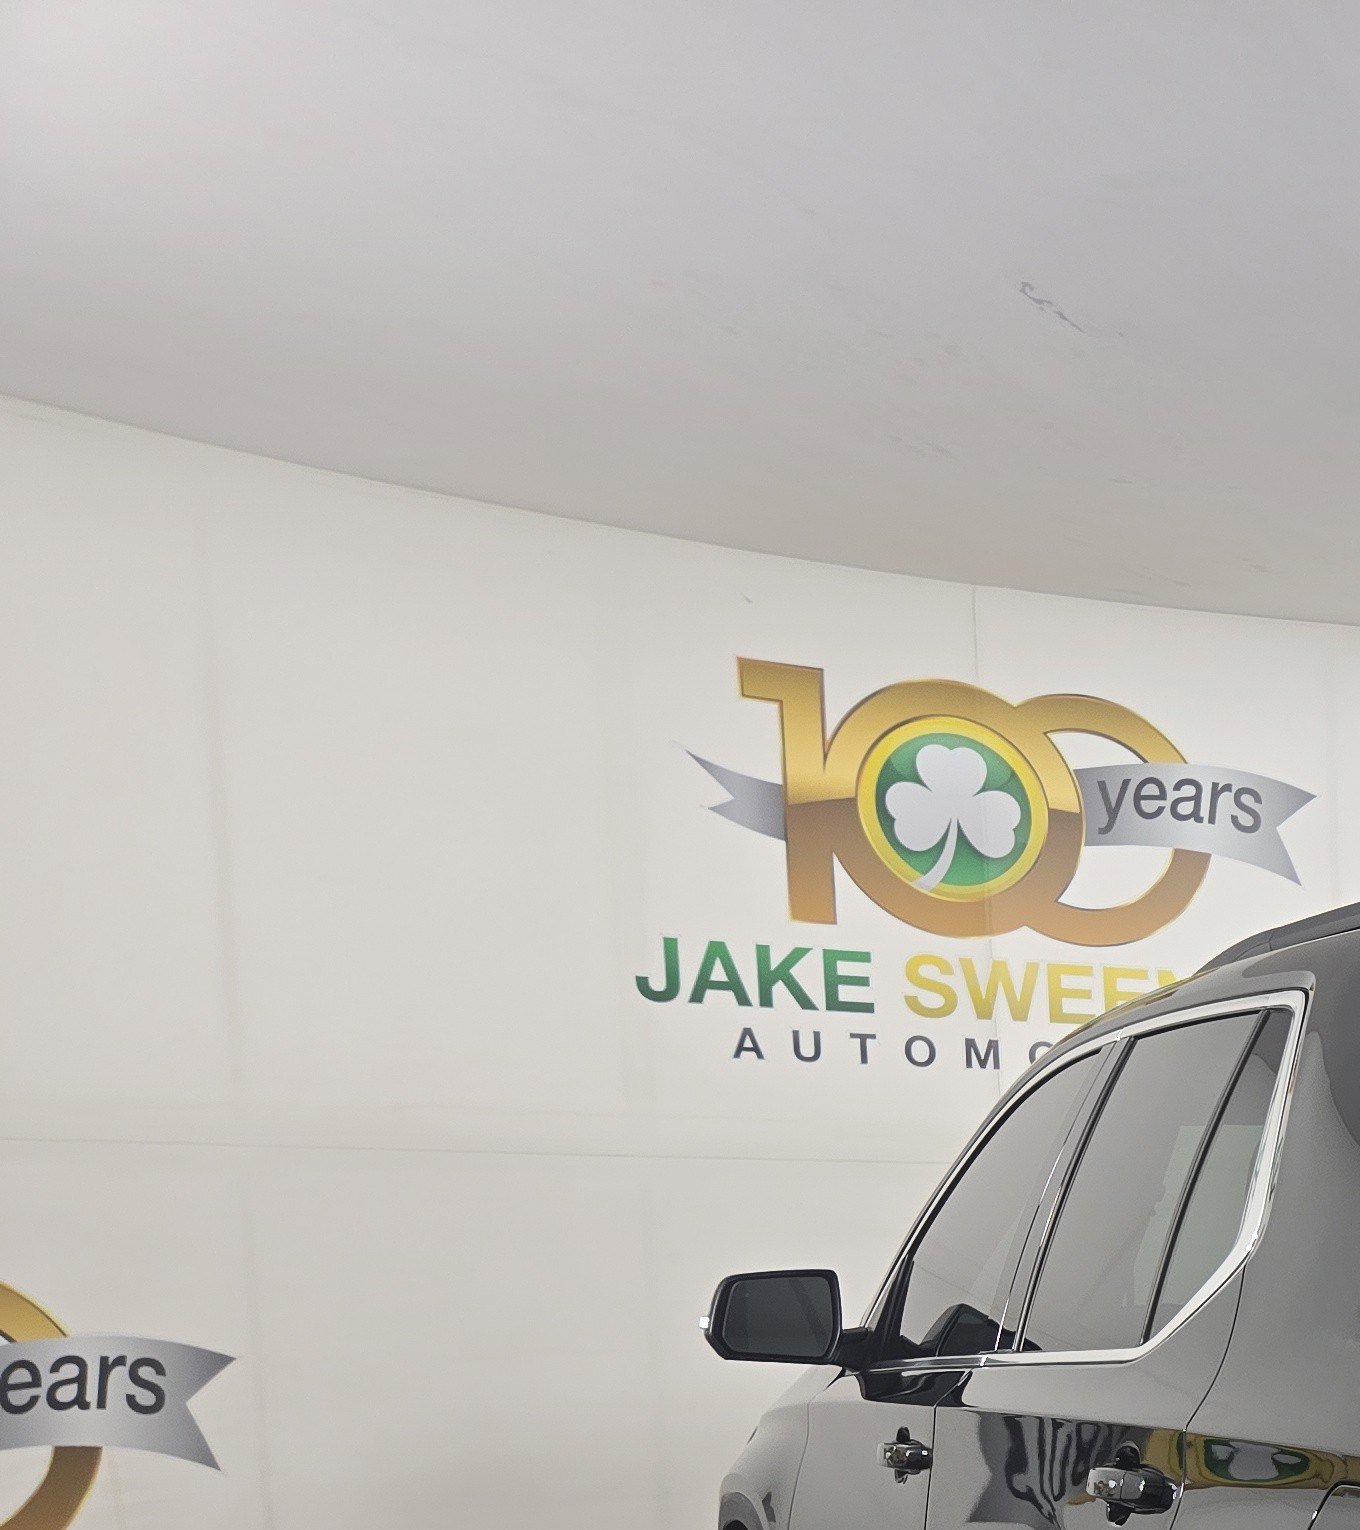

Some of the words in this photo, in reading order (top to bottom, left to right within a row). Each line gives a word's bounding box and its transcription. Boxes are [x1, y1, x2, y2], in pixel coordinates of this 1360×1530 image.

[736, 656, 1212, 947] 100
[1096, 770, 1264, 835] years
[634, 937, 876, 1015] JAKE
[903, 953, 1182, 1026] SWEE
